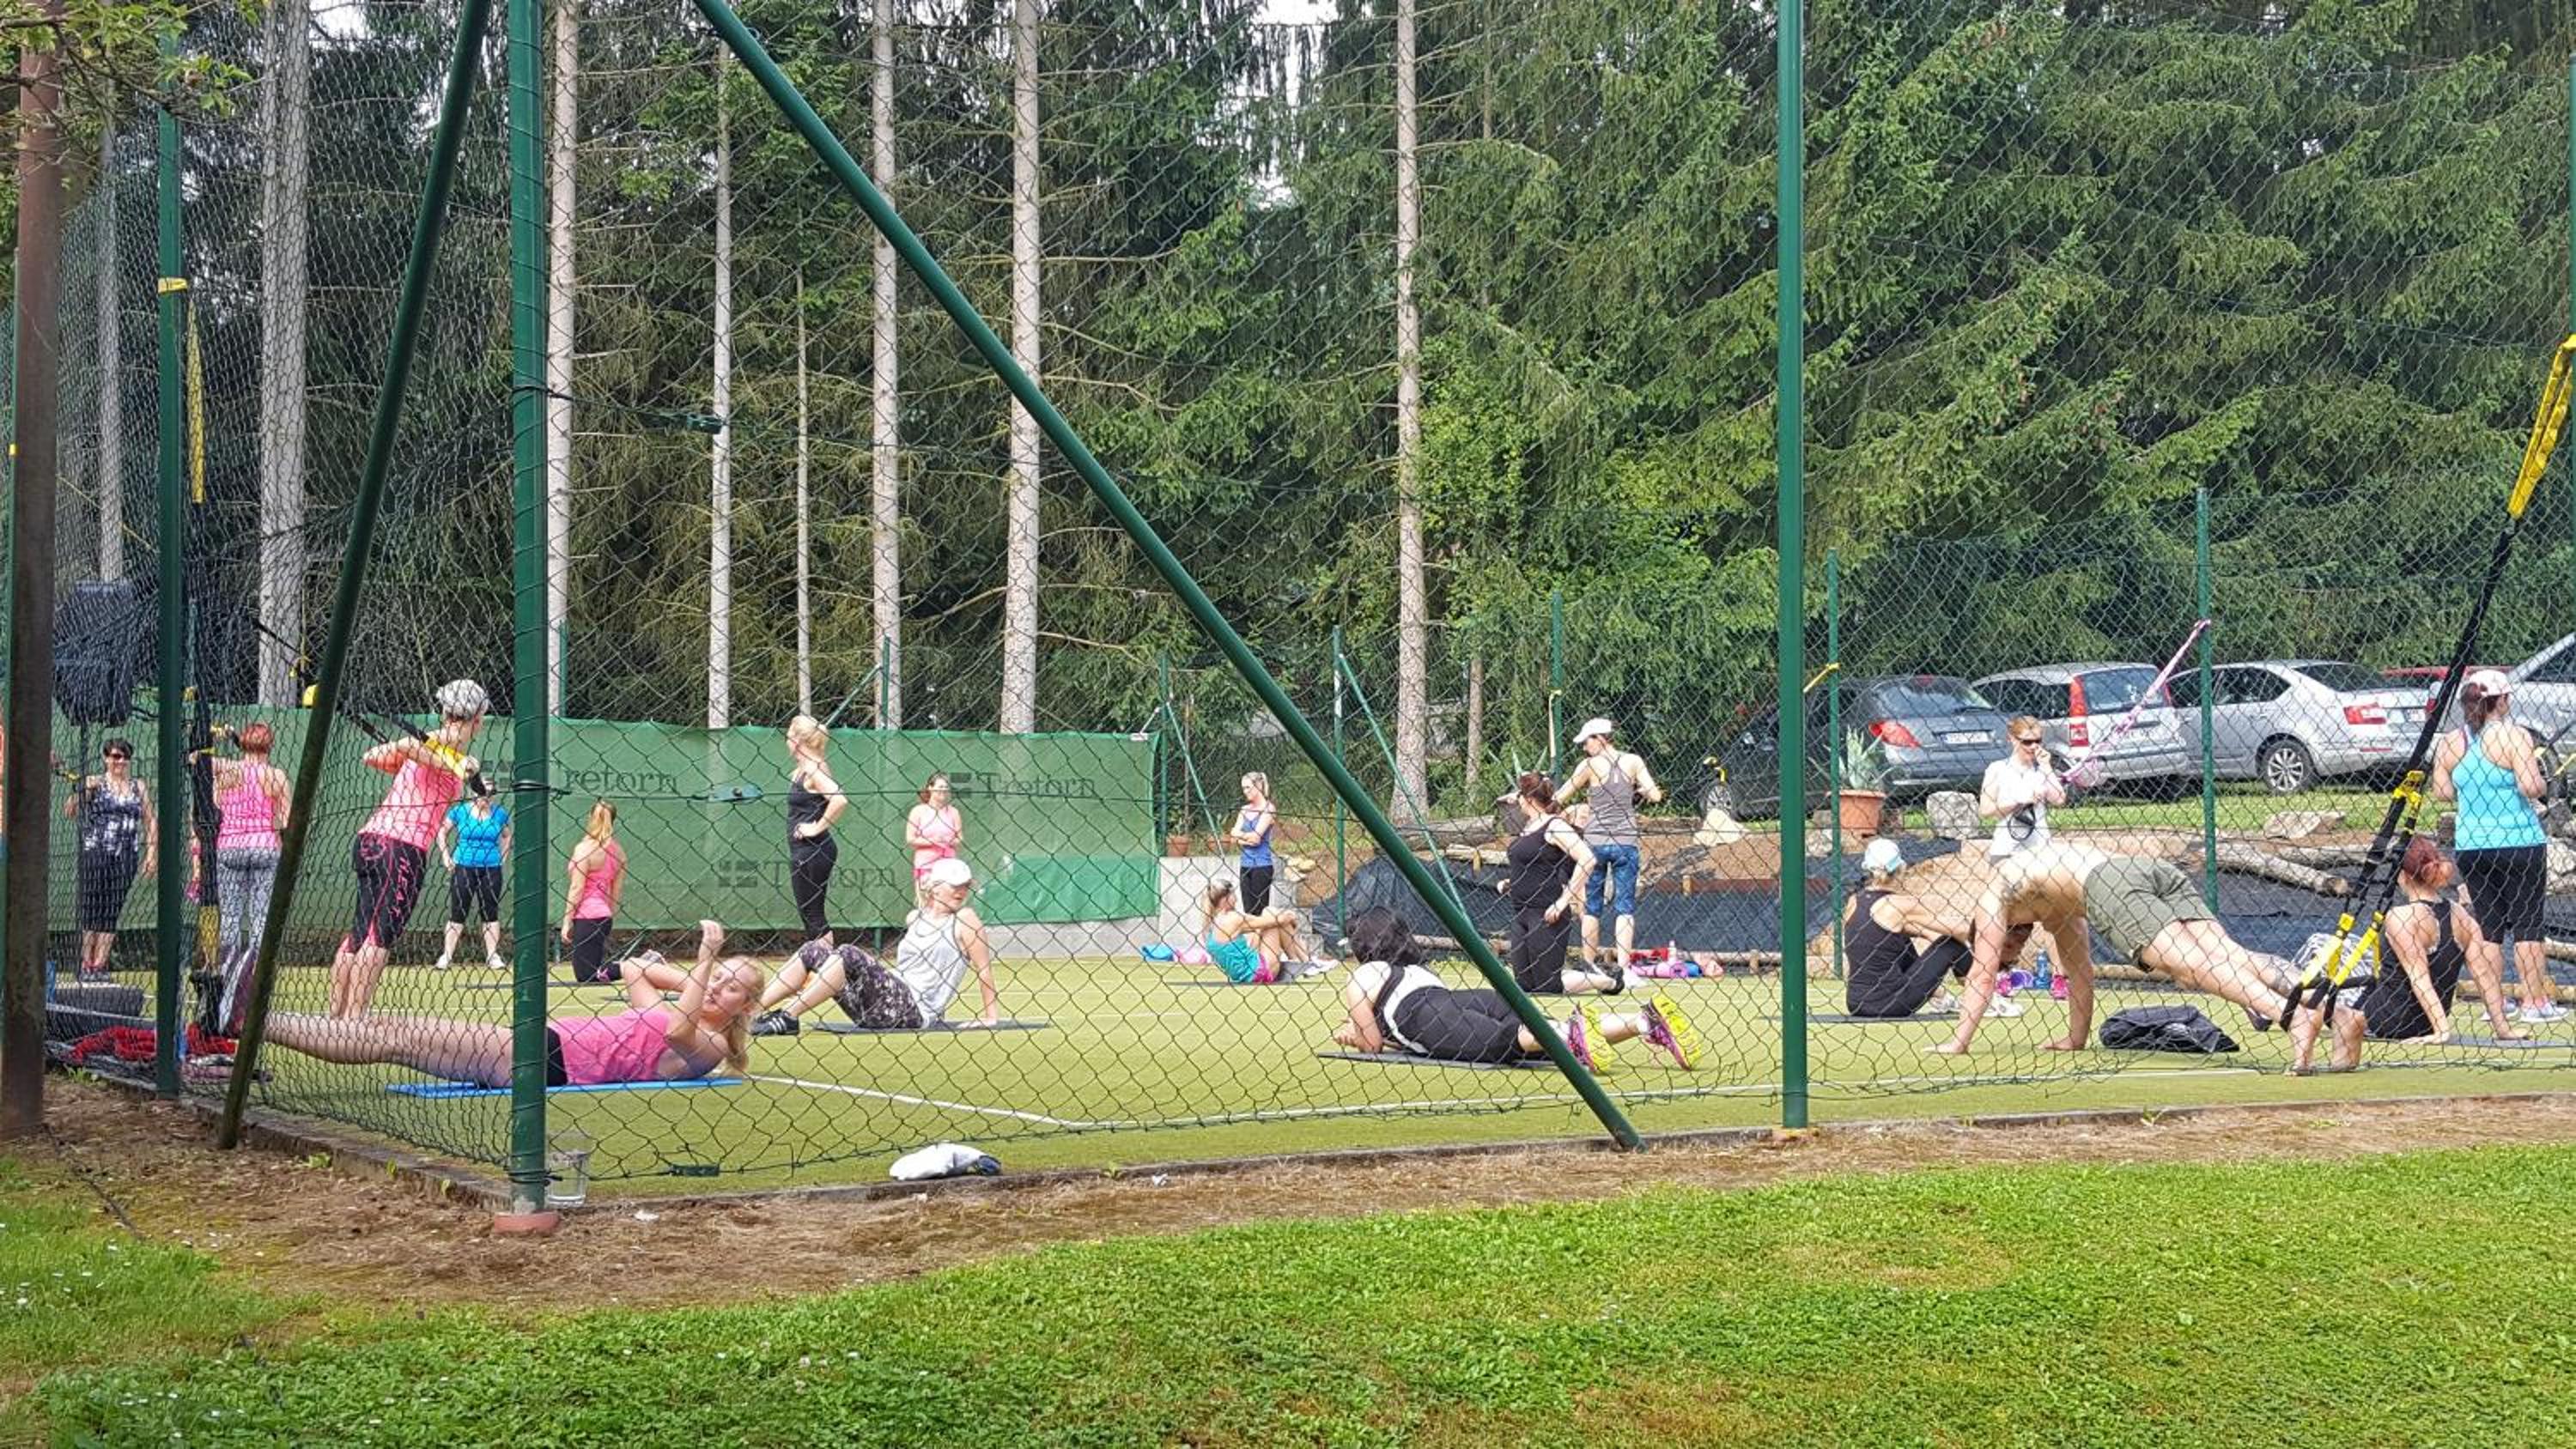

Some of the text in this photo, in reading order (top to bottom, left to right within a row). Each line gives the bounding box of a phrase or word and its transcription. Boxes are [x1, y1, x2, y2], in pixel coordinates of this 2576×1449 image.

[550, 761, 677, 793] retorn
[975, 772, 1096, 798] Tretorn
[763, 860, 895, 888] Torn
